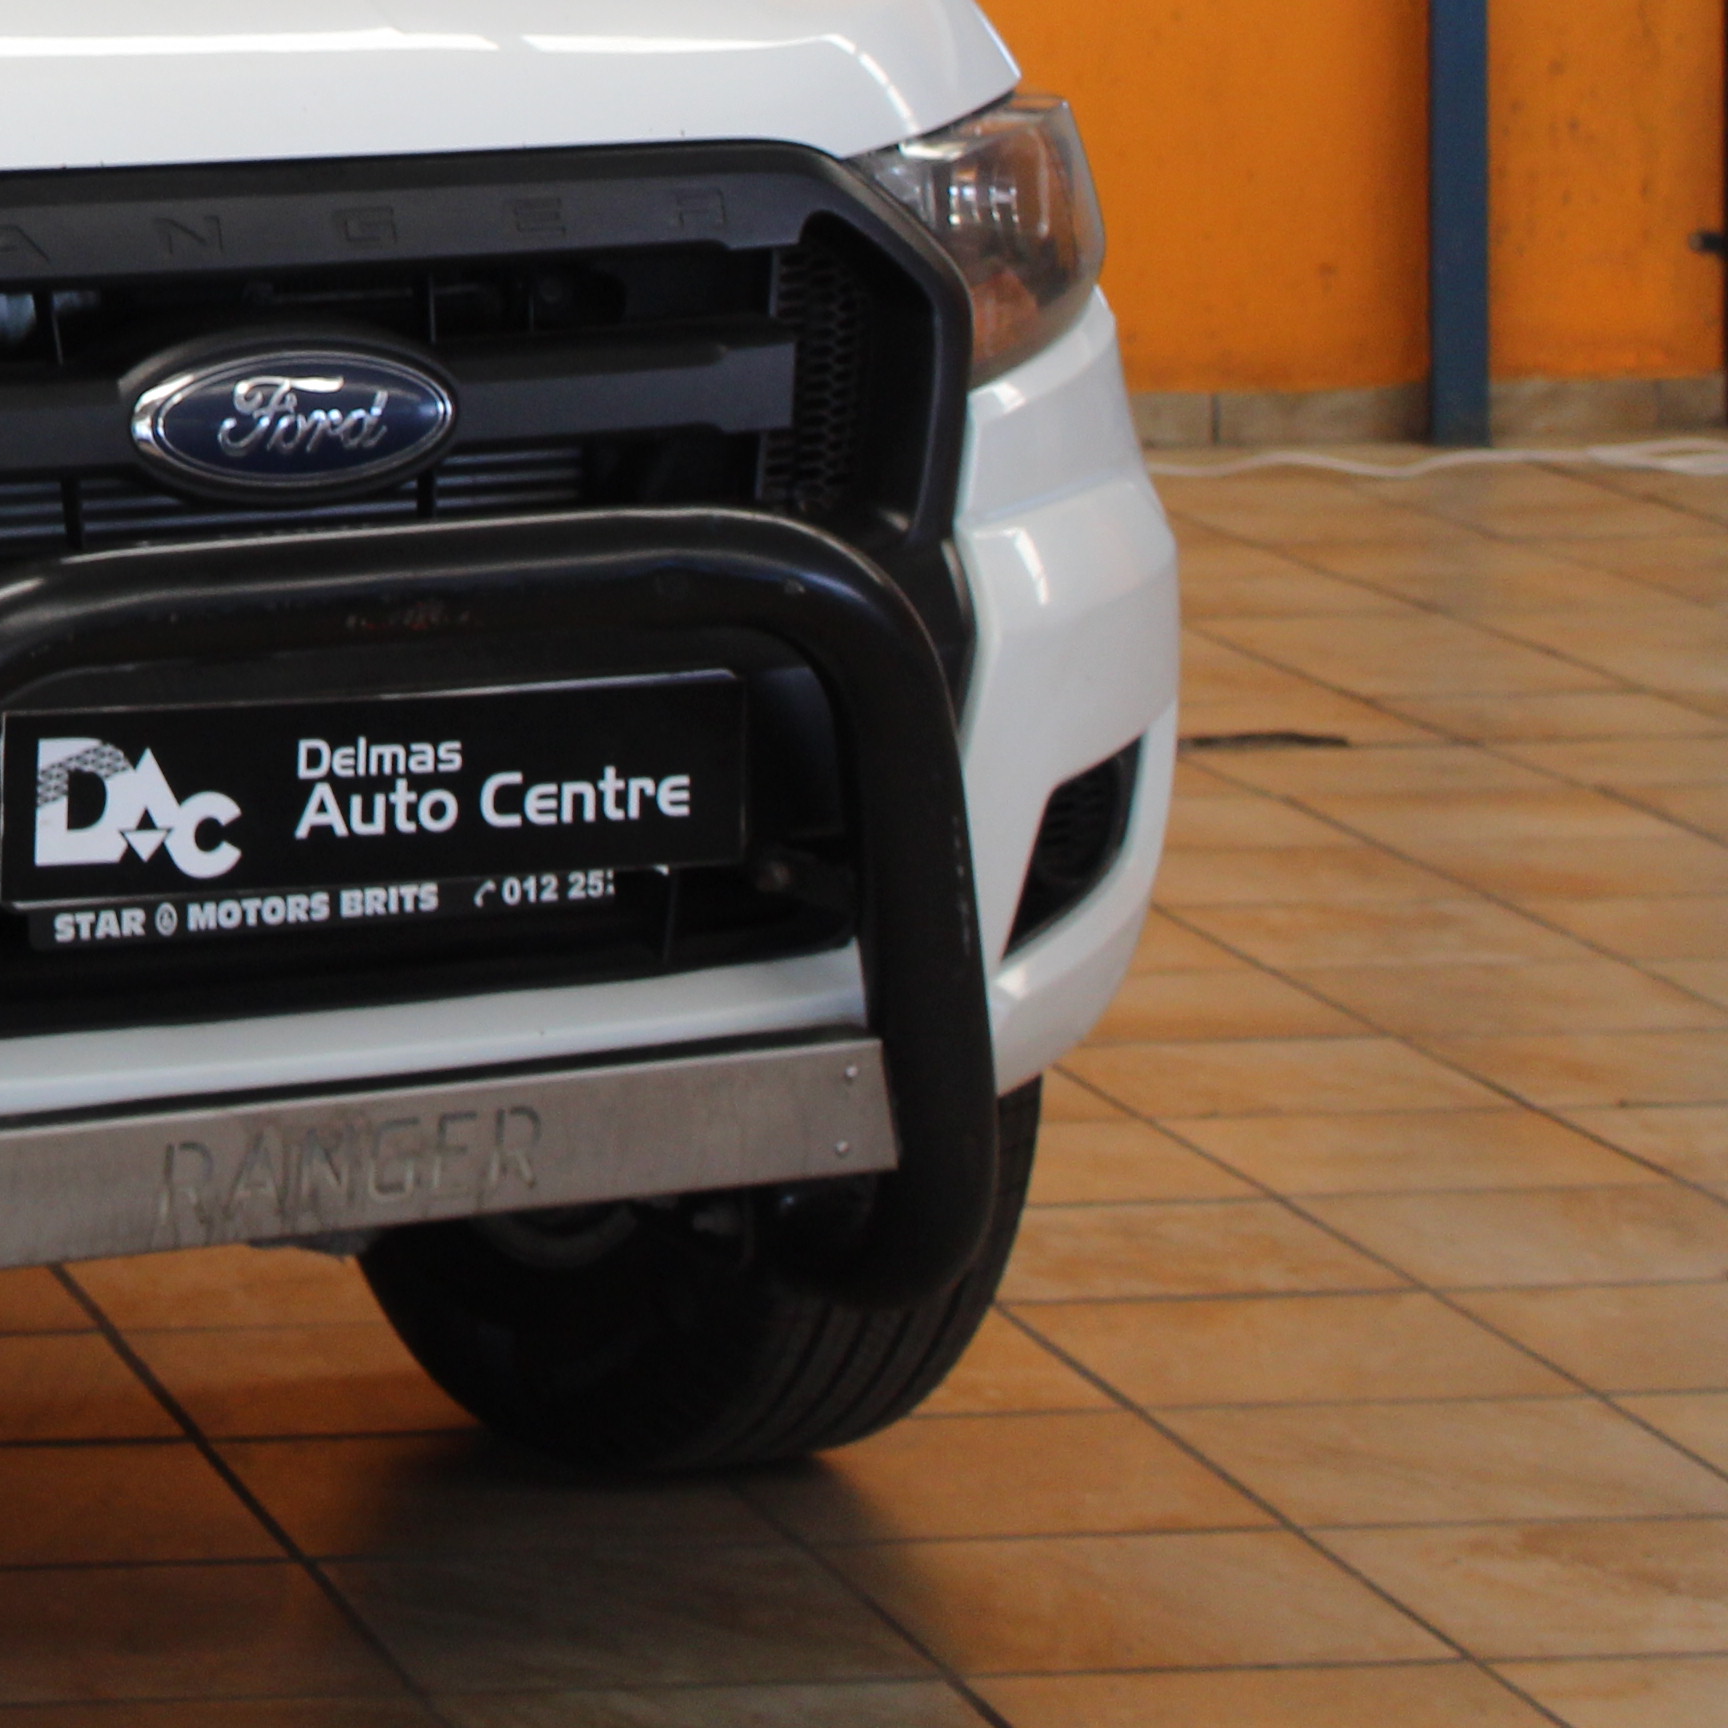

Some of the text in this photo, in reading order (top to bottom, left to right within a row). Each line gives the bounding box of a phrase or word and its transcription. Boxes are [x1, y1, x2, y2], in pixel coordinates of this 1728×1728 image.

[217, 374, 390, 456] Ford
[296, 736, 463, 780] Delmas
[294, 764, 692, 840] Auto Centre
[53, 906, 146, 943] STAR
[186, 890, 331, 932] MOTORS
[339, 882, 439, 919] BRITS
[501, 873, 559, 906] 012
[158, 1104, 543, 1226] RANGER
